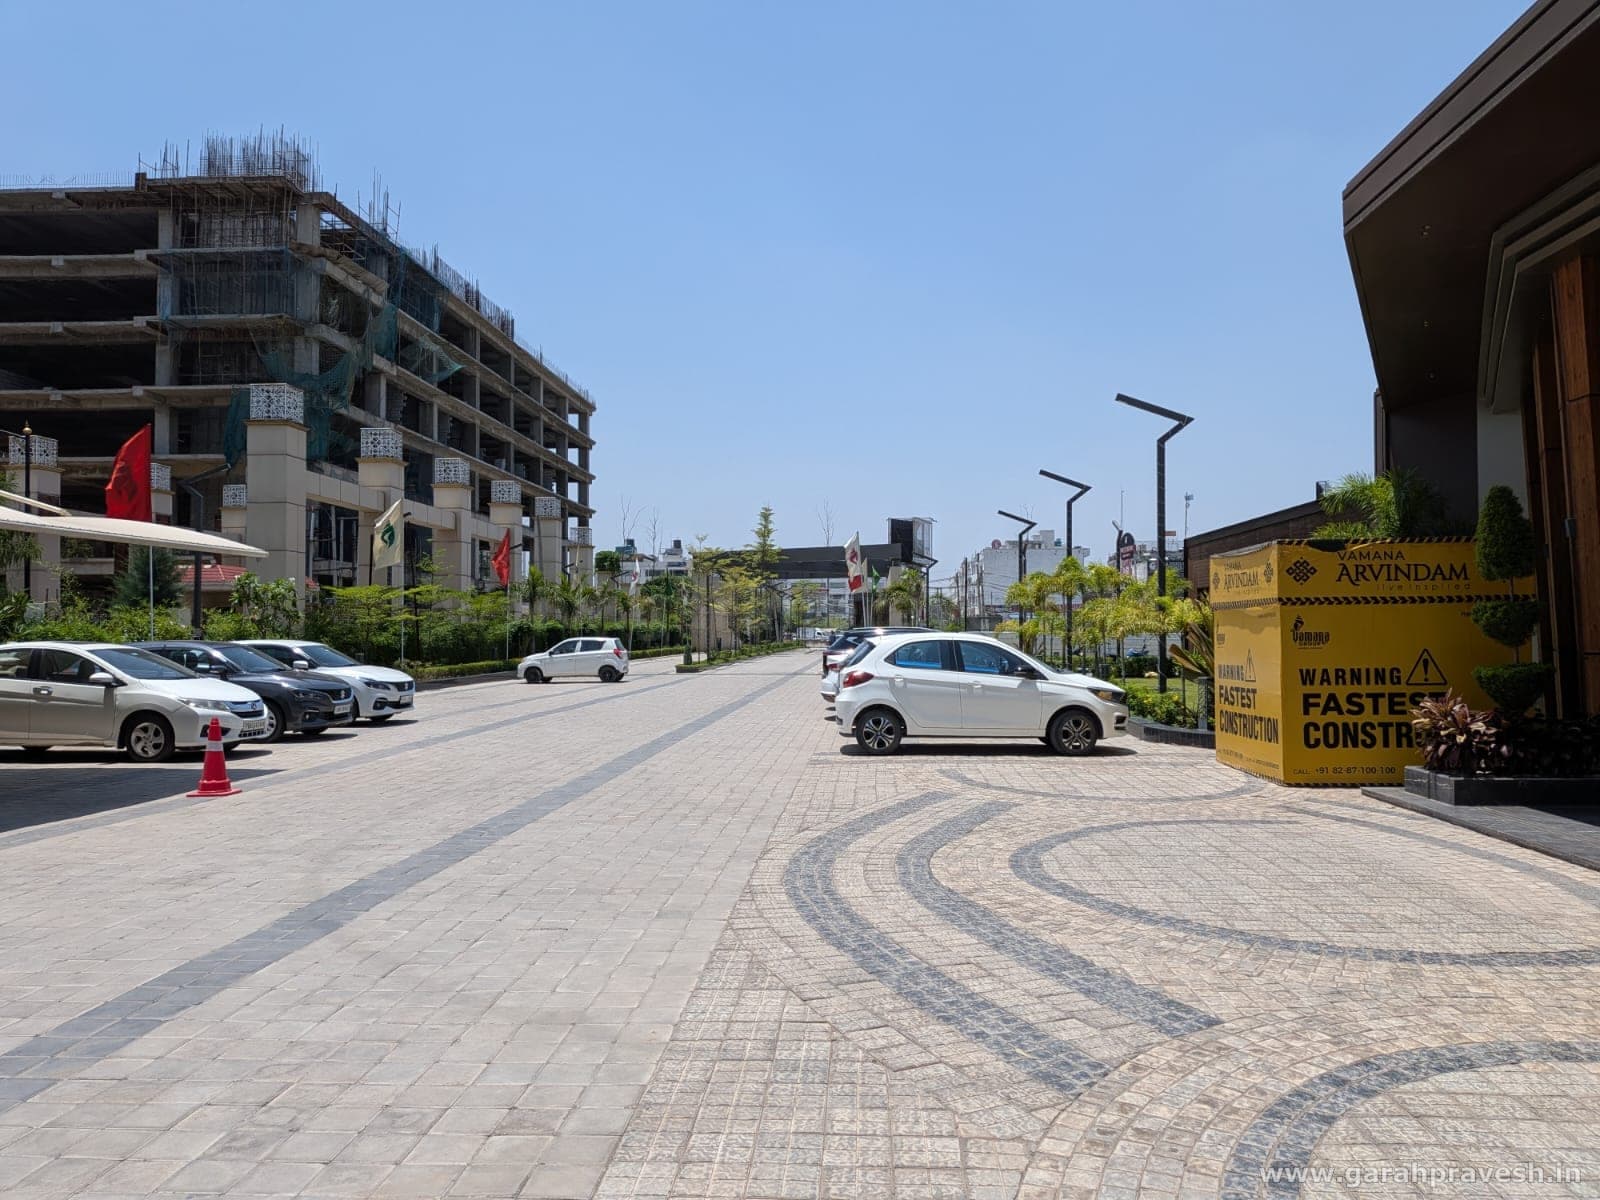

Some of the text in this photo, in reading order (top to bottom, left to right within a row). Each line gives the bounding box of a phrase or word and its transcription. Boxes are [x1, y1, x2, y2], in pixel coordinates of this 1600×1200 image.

[1337, 551, 1406, 561] VAMANA
[1336, 562, 1470, 586] ARVINDAM
[1218, 664, 1244, 681] WARNING
[1299, 667, 1402, 686] WARNING
[1219, 685, 1257, 709] FASTEST
[1220, 709, 1279, 744] CONSTRUCTION
